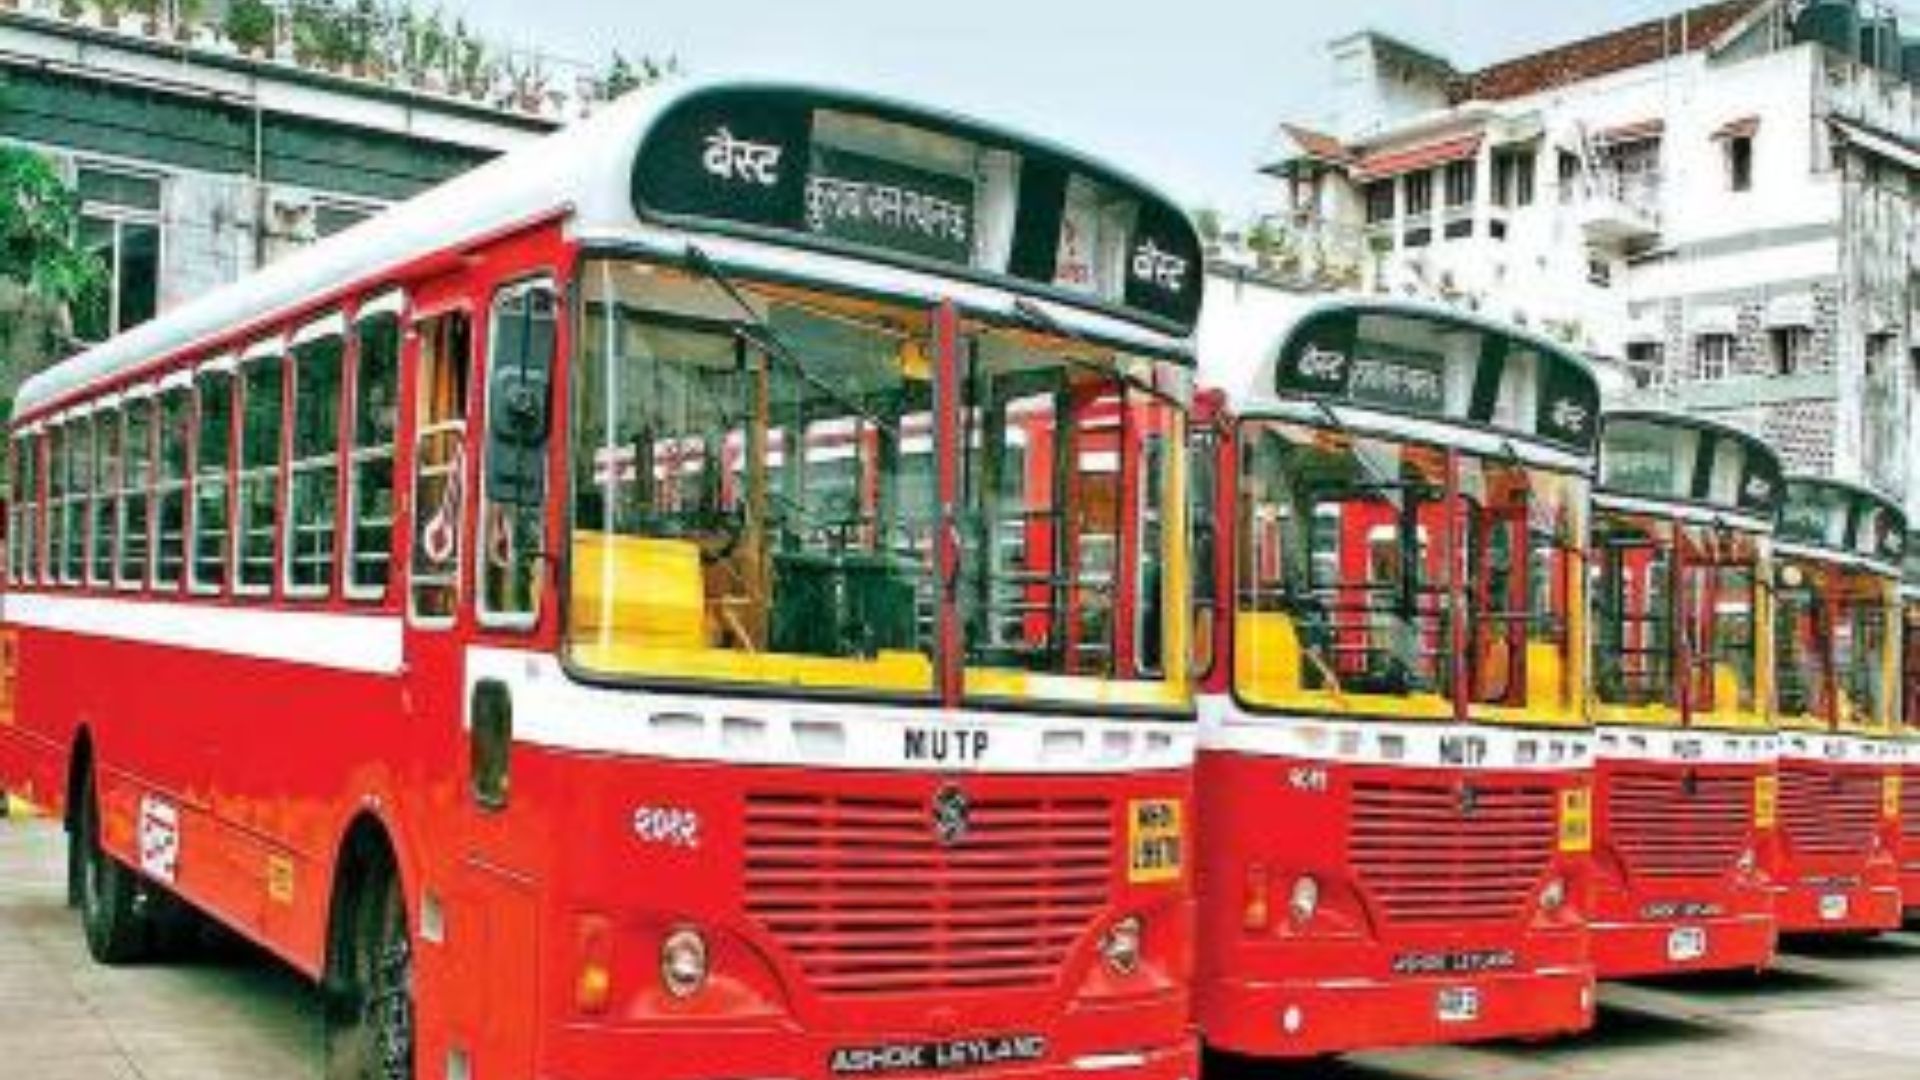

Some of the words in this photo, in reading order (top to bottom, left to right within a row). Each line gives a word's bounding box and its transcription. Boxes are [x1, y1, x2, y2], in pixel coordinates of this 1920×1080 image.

[702, 126, 781, 184] बेस्ट
[904, 728, 988, 759] MUTP
[831, 1046, 922, 1071] ASHOK
[936, 1036, 1044, 1067] LEYLAND
